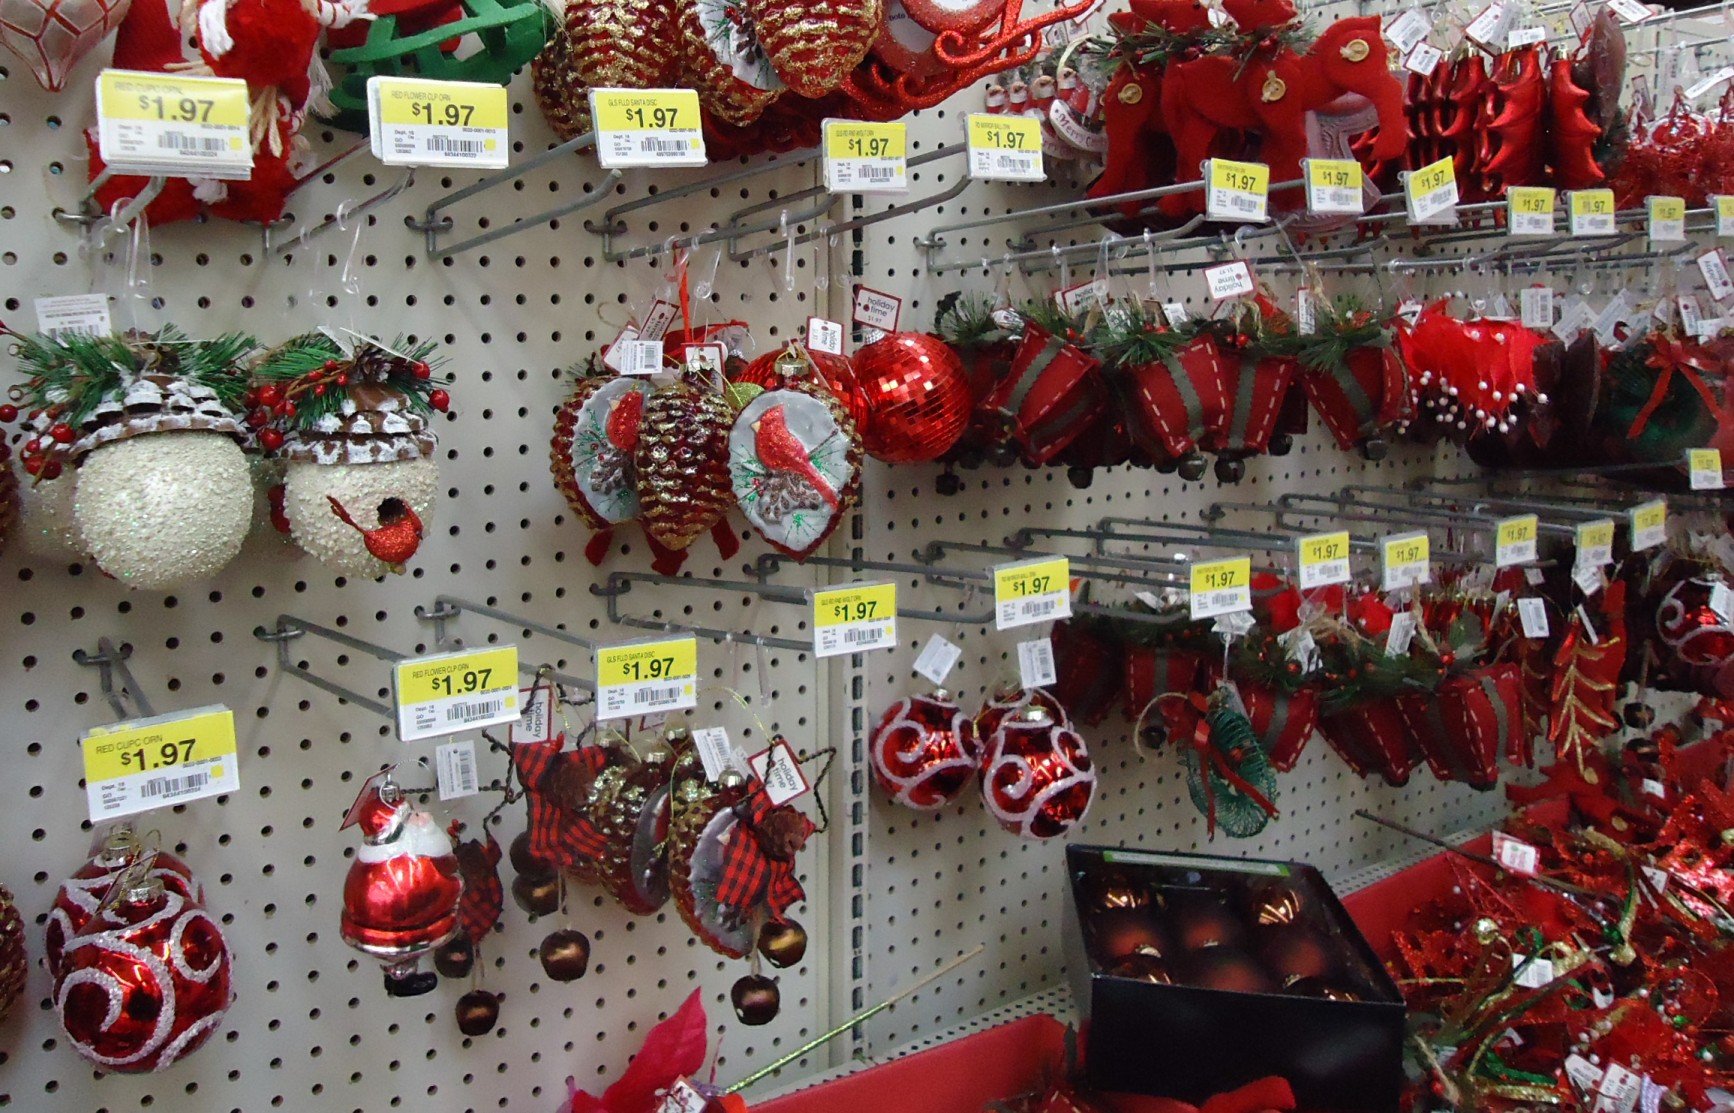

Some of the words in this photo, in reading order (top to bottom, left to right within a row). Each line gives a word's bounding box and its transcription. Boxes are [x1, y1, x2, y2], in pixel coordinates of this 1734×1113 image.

[392, 90, 404, 99] RED
[404, 91, 427, 101] FLOWER
[139, 95, 214, 122] $1.97
[411, 102, 475, 126] $1.97
[626, 108, 678, 128] $1.97
[848, 138, 889, 157] $1.97
[987, 130, 1025, 149] $1.97
[1226, 172, 1256, 191] $1.97
[1323, 171, 1349, 186] $1.97
[1421, 170, 1445, 190] $1.97
[1523, 199, 1545, 212] $1.97
[1214, 281, 1243, 292] holiday
[867, 296, 896, 313] holiday
[870, 306, 888, 317] time
[1507, 527, 1528, 541] $1.97
[1313, 544, 1339, 559] $1.97
[1396, 546, 1419, 562] $1.97
[1013, 576, 1050, 596] $1.97
[1205, 571, 1235, 588] $1.97
[834, 601, 877, 621] $1.97
[412, 670, 424, 679] RED
[424, 666, 447, 677] FLOWER
[622, 657, 674, 680] $1.97
[432, 668, 492, 696] $1.97
[532, 701, 544, 738] holiday
[96, 743, 115, 754] RED
[116, 738, 141, 751] CUPC
[143, 735, 163, 744] ORN
[121, 738, 196, 771] $1.97
[772, 768, 787, 789] time
[777, 757, 798, 791] holiday
